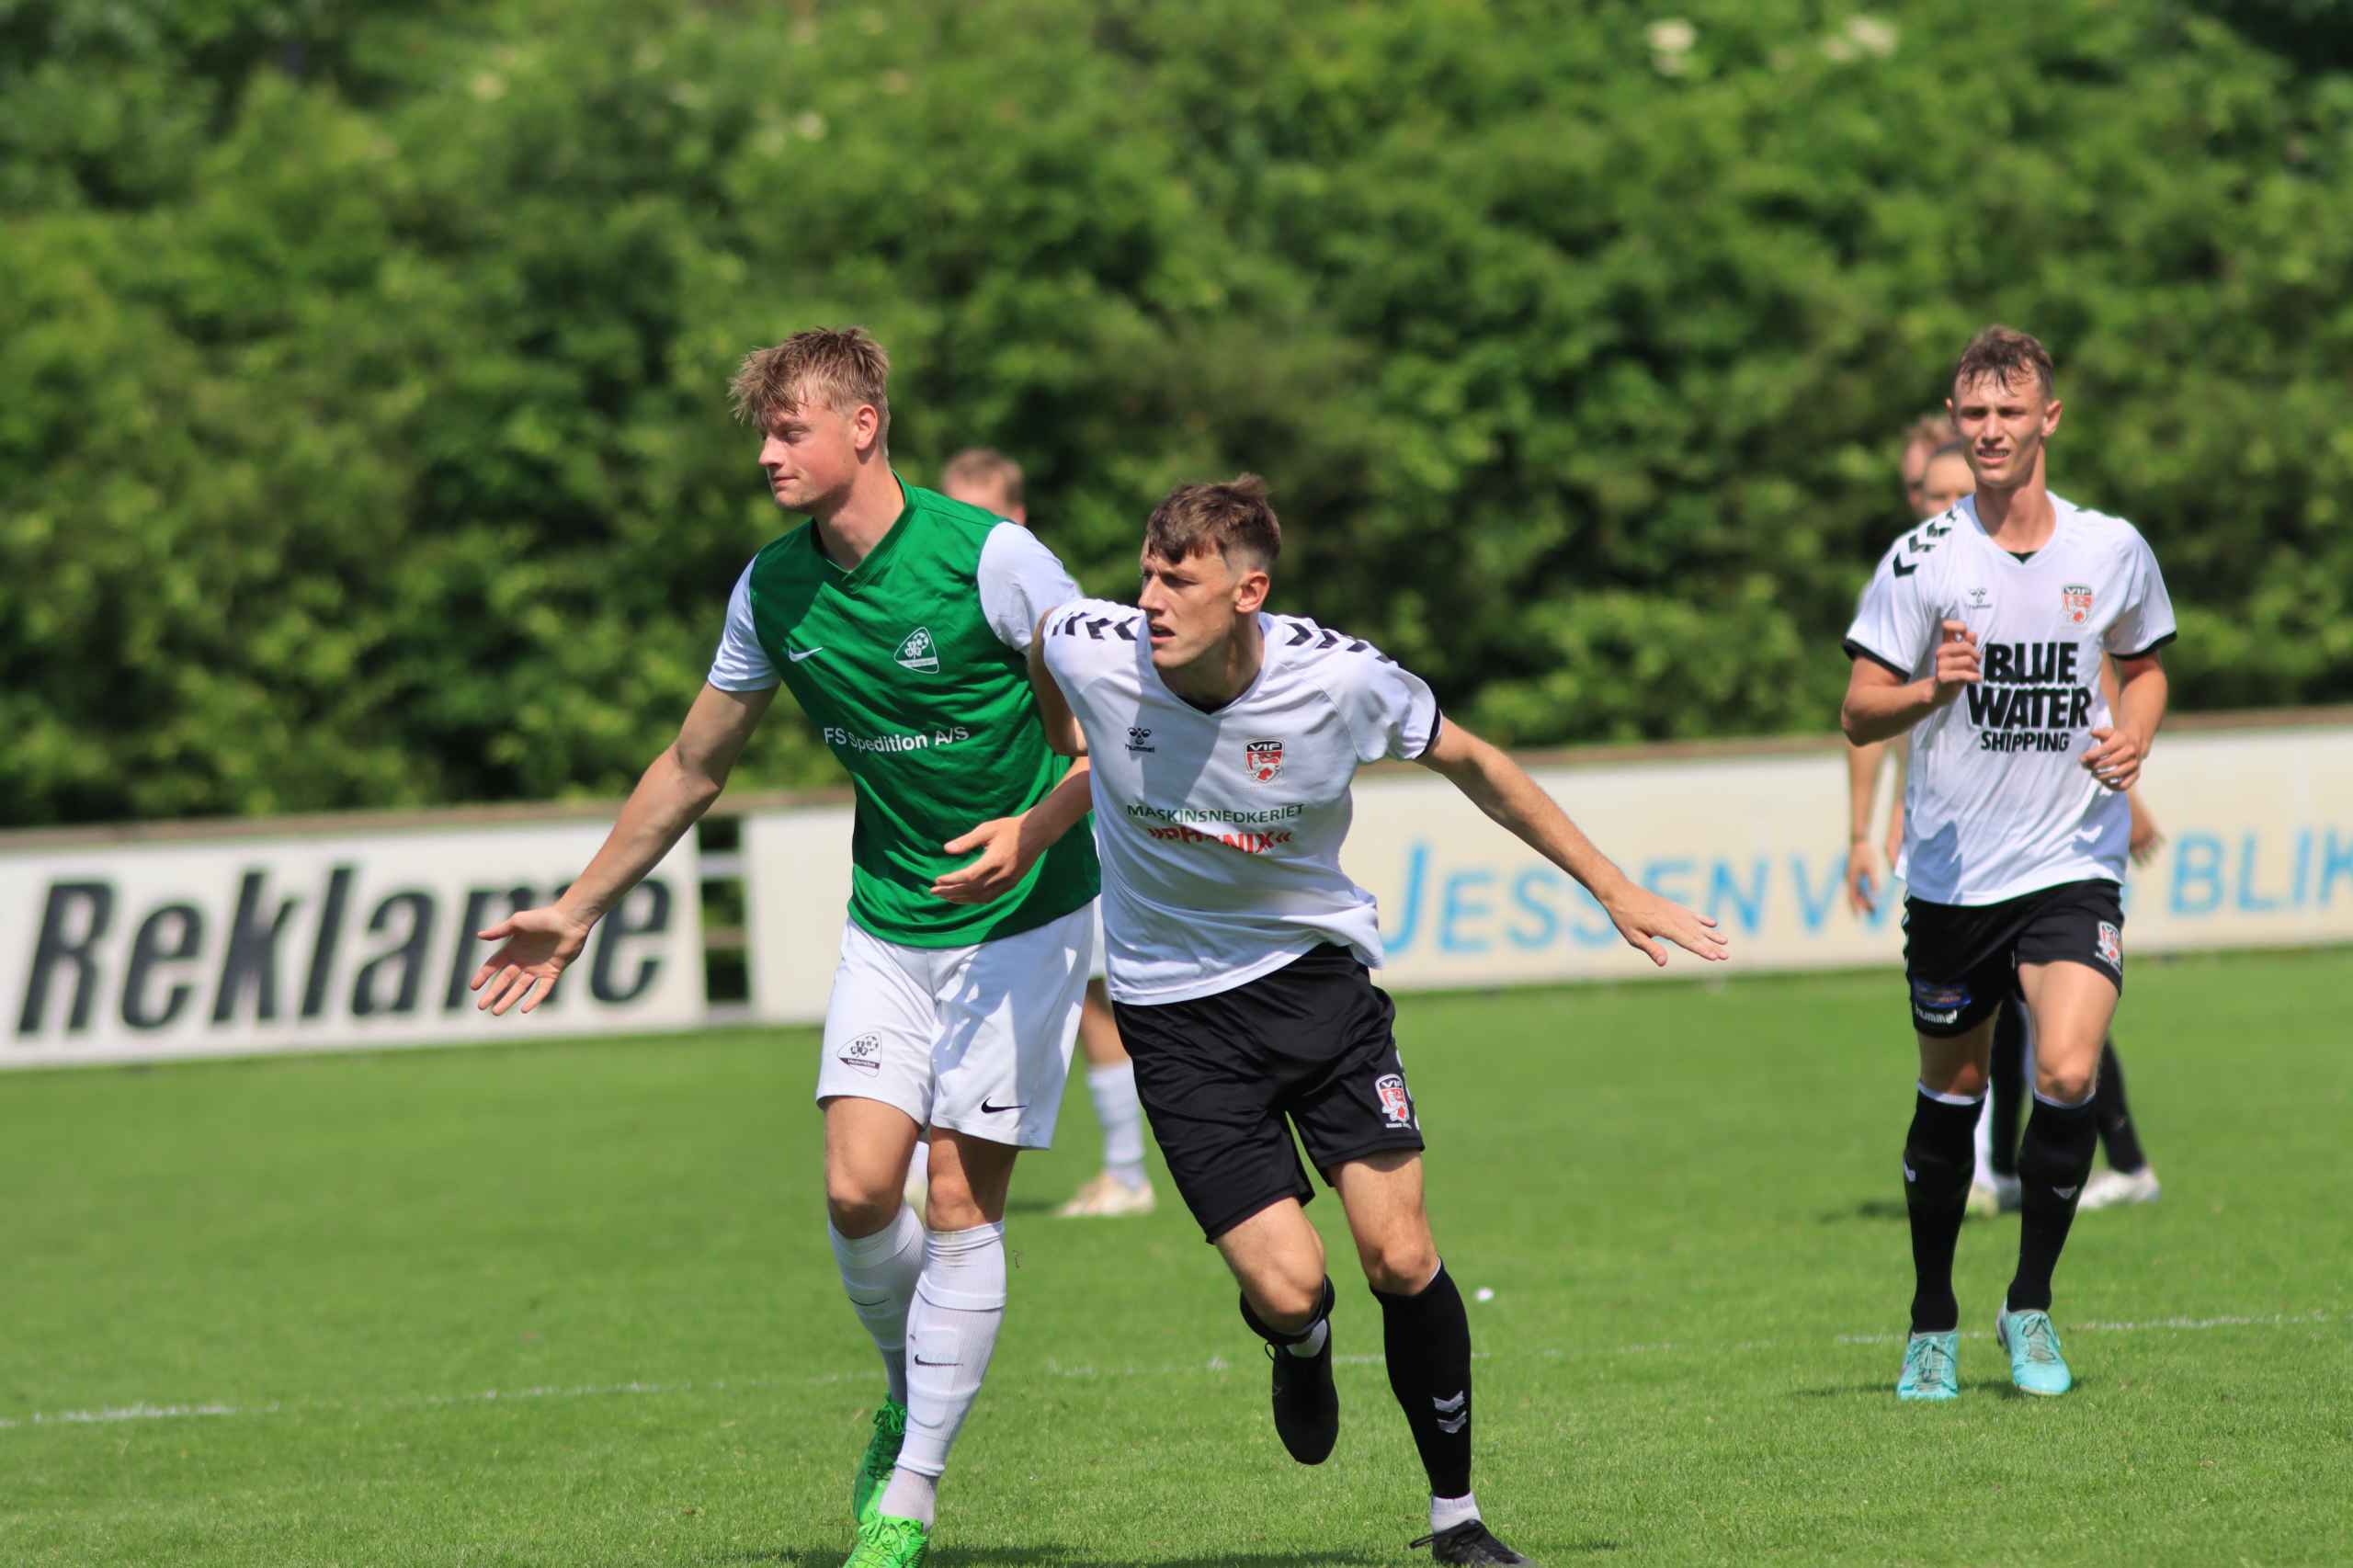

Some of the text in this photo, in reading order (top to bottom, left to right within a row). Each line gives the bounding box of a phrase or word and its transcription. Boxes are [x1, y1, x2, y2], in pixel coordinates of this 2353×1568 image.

[1984, 642, 2079, 685] BLUE
[1967, 683, 2092, 729] WATER
[824, 726, 971, 754] FS Spedition A/S
[1249, 743, 1280, 751] VIF
[1981, 731, 2069, 752] SHIPPING
[1127, 803, 1305, 824] MASKINSNEDKERIET
